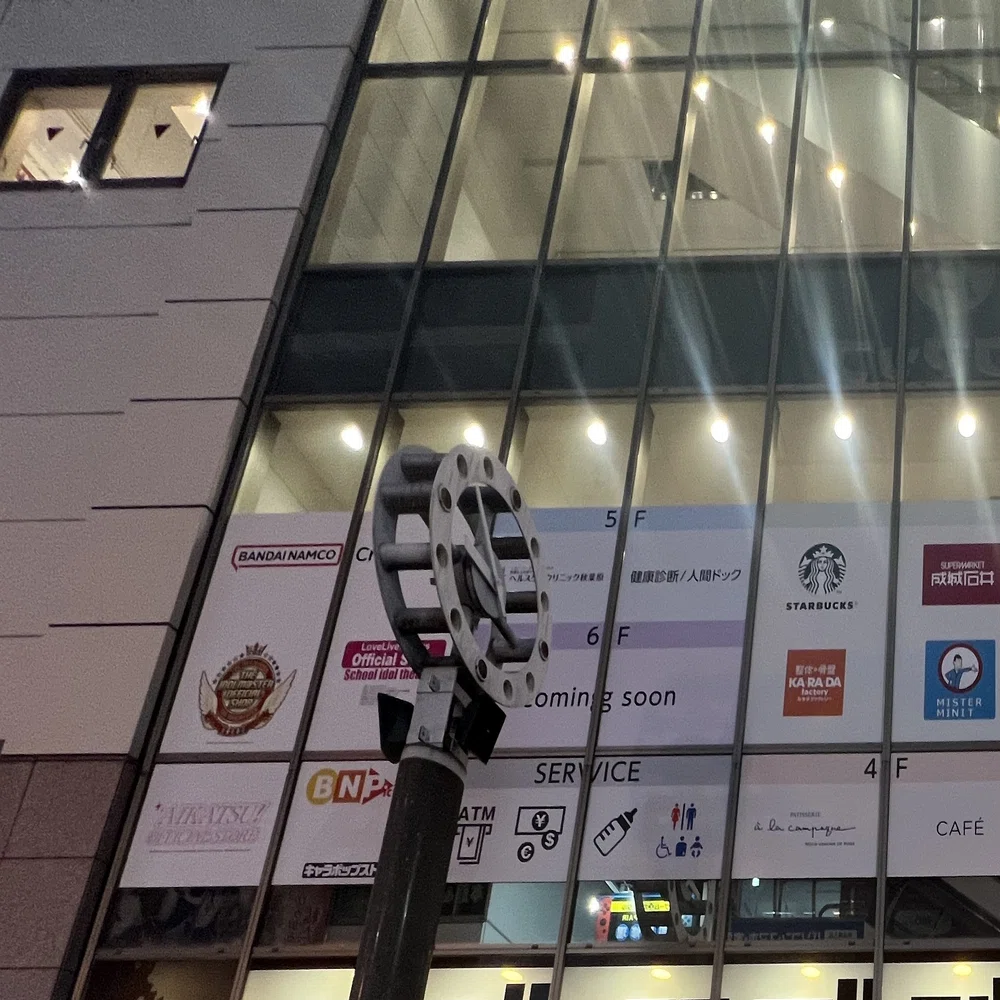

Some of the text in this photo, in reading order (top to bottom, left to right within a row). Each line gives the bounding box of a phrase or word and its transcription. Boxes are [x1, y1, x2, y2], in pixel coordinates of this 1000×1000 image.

[931, 571, 995, 587] 成城石井
[786, 602, 854, 610] STARBUCKS
[344, 668, 378, 680] School
[524, 687, 676, 713] oming soon
[936, 698, 982, 707] MISTER
[936, 708, 973, 717] MINIT
[533, 760, 641, 784] SERVICE
[460, 806, 496, 821] ATM
[936, 817, 984, 836] CAFÉ
